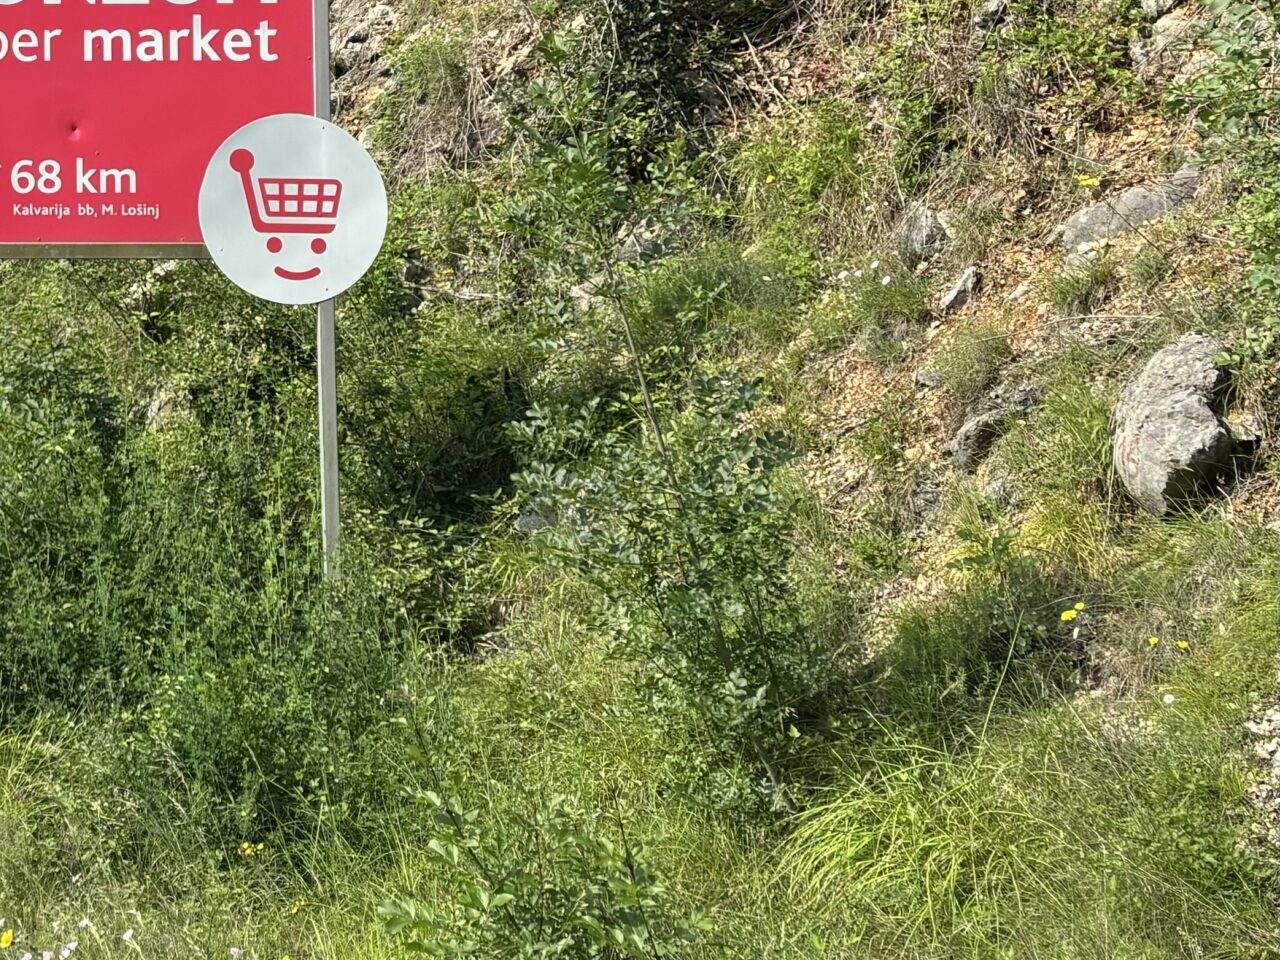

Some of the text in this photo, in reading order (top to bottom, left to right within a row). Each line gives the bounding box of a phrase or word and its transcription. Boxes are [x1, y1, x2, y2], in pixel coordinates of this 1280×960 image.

[83, 14, 279, 62] market
[10, 157, 137, 194] 68 km
[12, 203, 160, 219] Kalvarija bb, M. Lošinj
